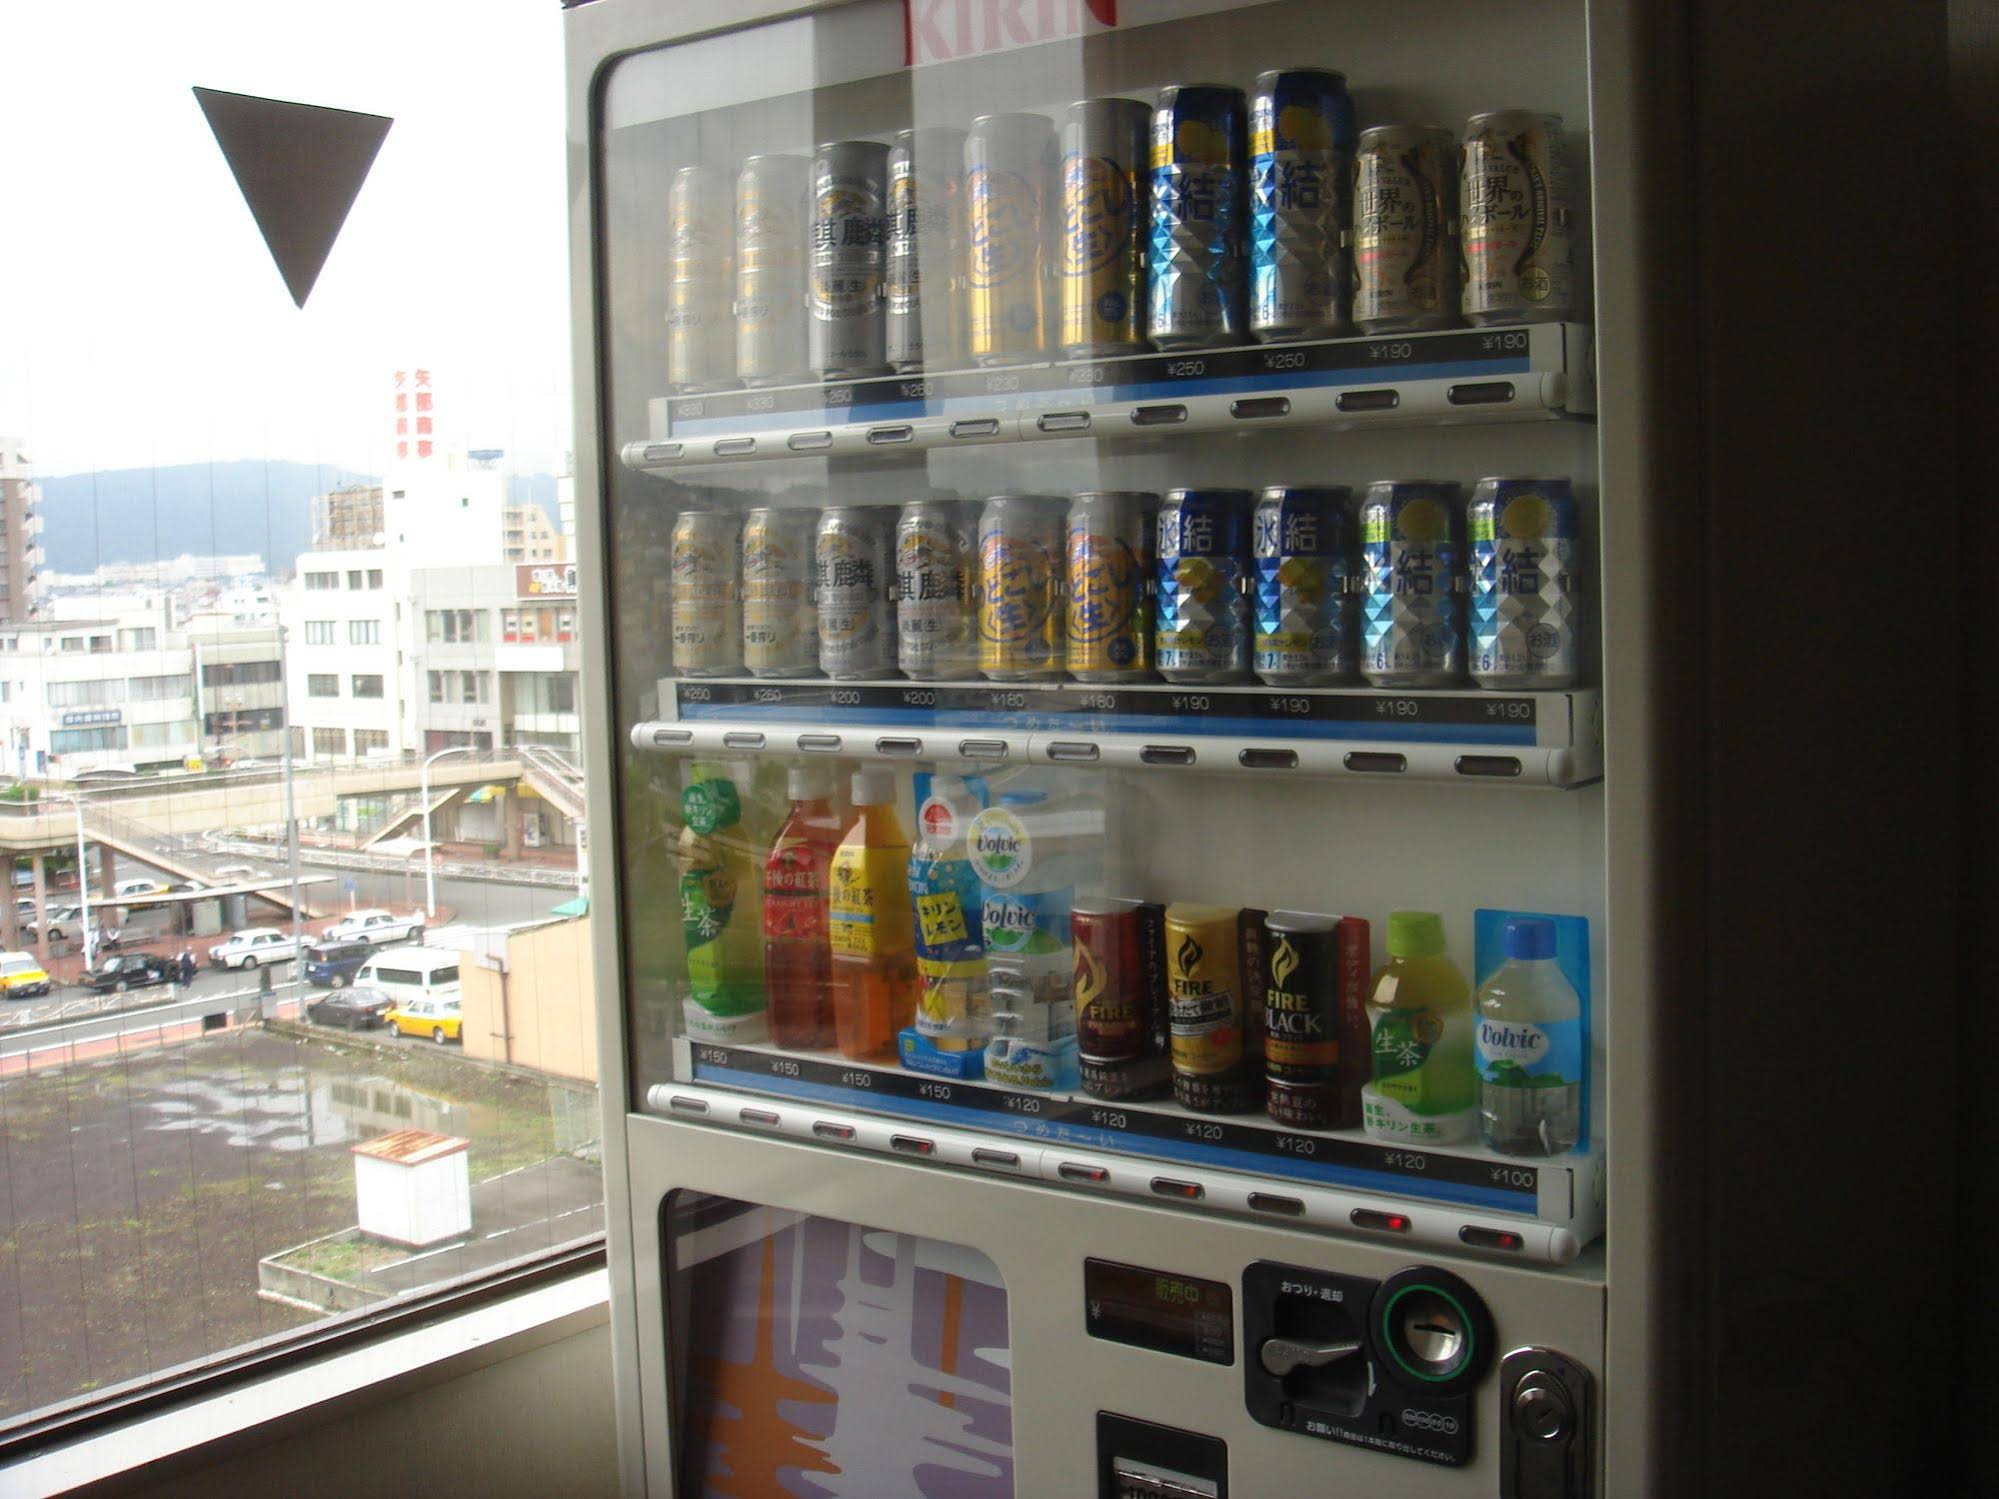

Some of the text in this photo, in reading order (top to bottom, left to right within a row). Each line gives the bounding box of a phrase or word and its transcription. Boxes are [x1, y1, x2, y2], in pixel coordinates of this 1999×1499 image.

[1482, 333, 1528, 349] ¥190
[1368, 343, 1412, 359] ¥190
[1167, 361, 1205, 376] ¥250
[1264, 352, 1306, 369] ¥250
[904, 691, 935, 705] ¥200
[1171, 696, 1209, 710] ¥190
[1271, 698, 1310, 713] ¥190
[1375, 700, 1418, 716] ¥190
[1486, 703, 1530, 718] ¥190
[977, 835, 1021, 854] Volvic
[681, 895, 720, 937] 生茶
[1174, 980, 1214, 995] FIRE
[1267, 989, 1309, 1012] FIRE
[1090, 1006, 1133, 1020] FIRE
[1482, 1024, 1541, 1049] Volvic
[1374, 1027, 1422, 1067] 生茶
[701, 1051, 728, 1064] ¥150
[772, 1061, 799, 1076] ¥150
[842, 1072, 871, 1087] ¥150
[920, 1084, 951, 1099] ¥150
[1007, 1096, 1041, 1113] ¥120
[1091, 1110, 1127, 1129] ¥120
[1184, 1123, 1223, 1140] ¥120
[1275, 1136, 1315, 1155] ¥120
[1383, 1153, 1425, 1170] ¥120
[1489, 1169, 1533, 1188] ¥100
